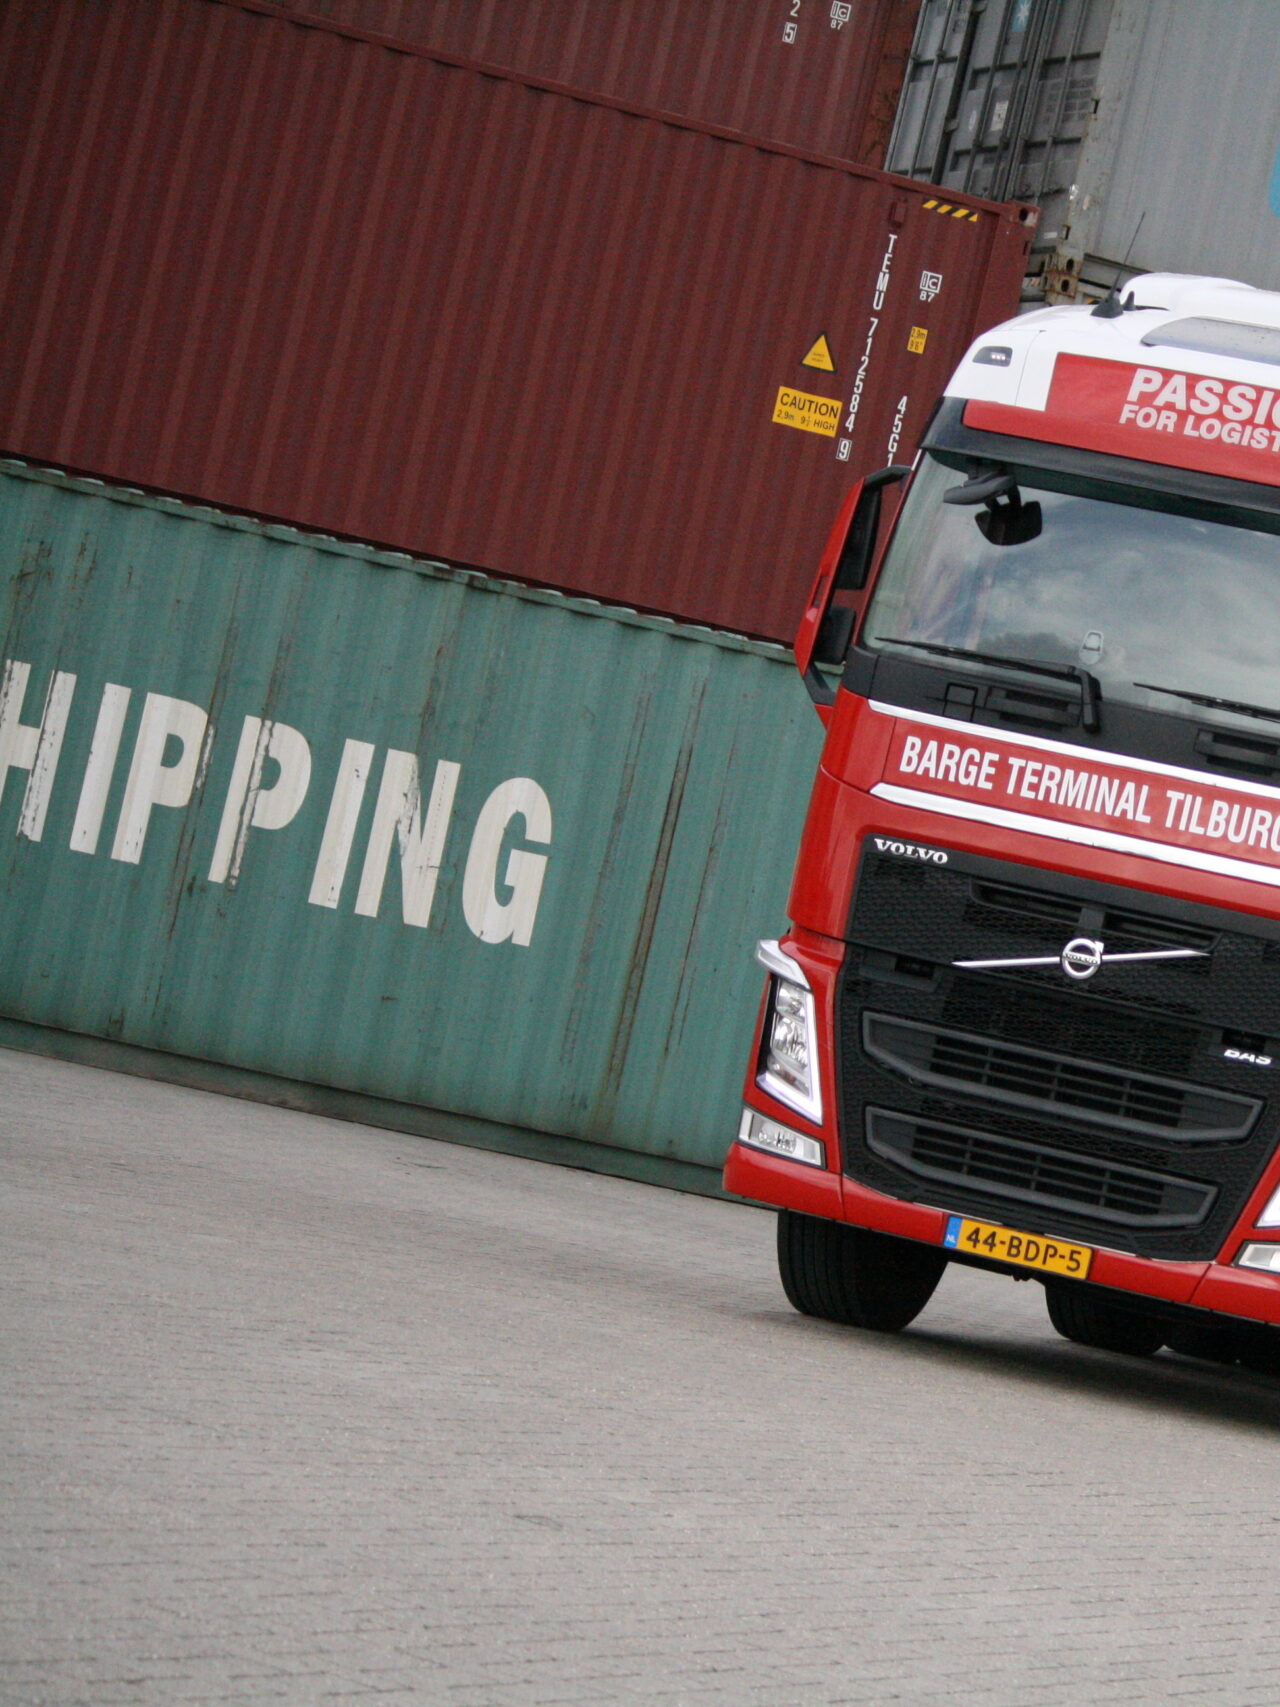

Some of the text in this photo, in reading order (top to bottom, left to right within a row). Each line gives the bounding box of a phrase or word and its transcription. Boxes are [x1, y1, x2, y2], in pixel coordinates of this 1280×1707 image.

[919, 290, 935, 302] 87
[780, 393, 839, 419] CAUTION
[1119, 404, 1178, 433] FOR
[813, 419, 836, 432] HIGH
[899, 735, 999, 791] BARGE
[1006, 757, 1152, 824] TERMINAL
[874, 838, 949, 865] VOLVO
[945, 1226, 1083, 1273] NL 44-BDP-5
